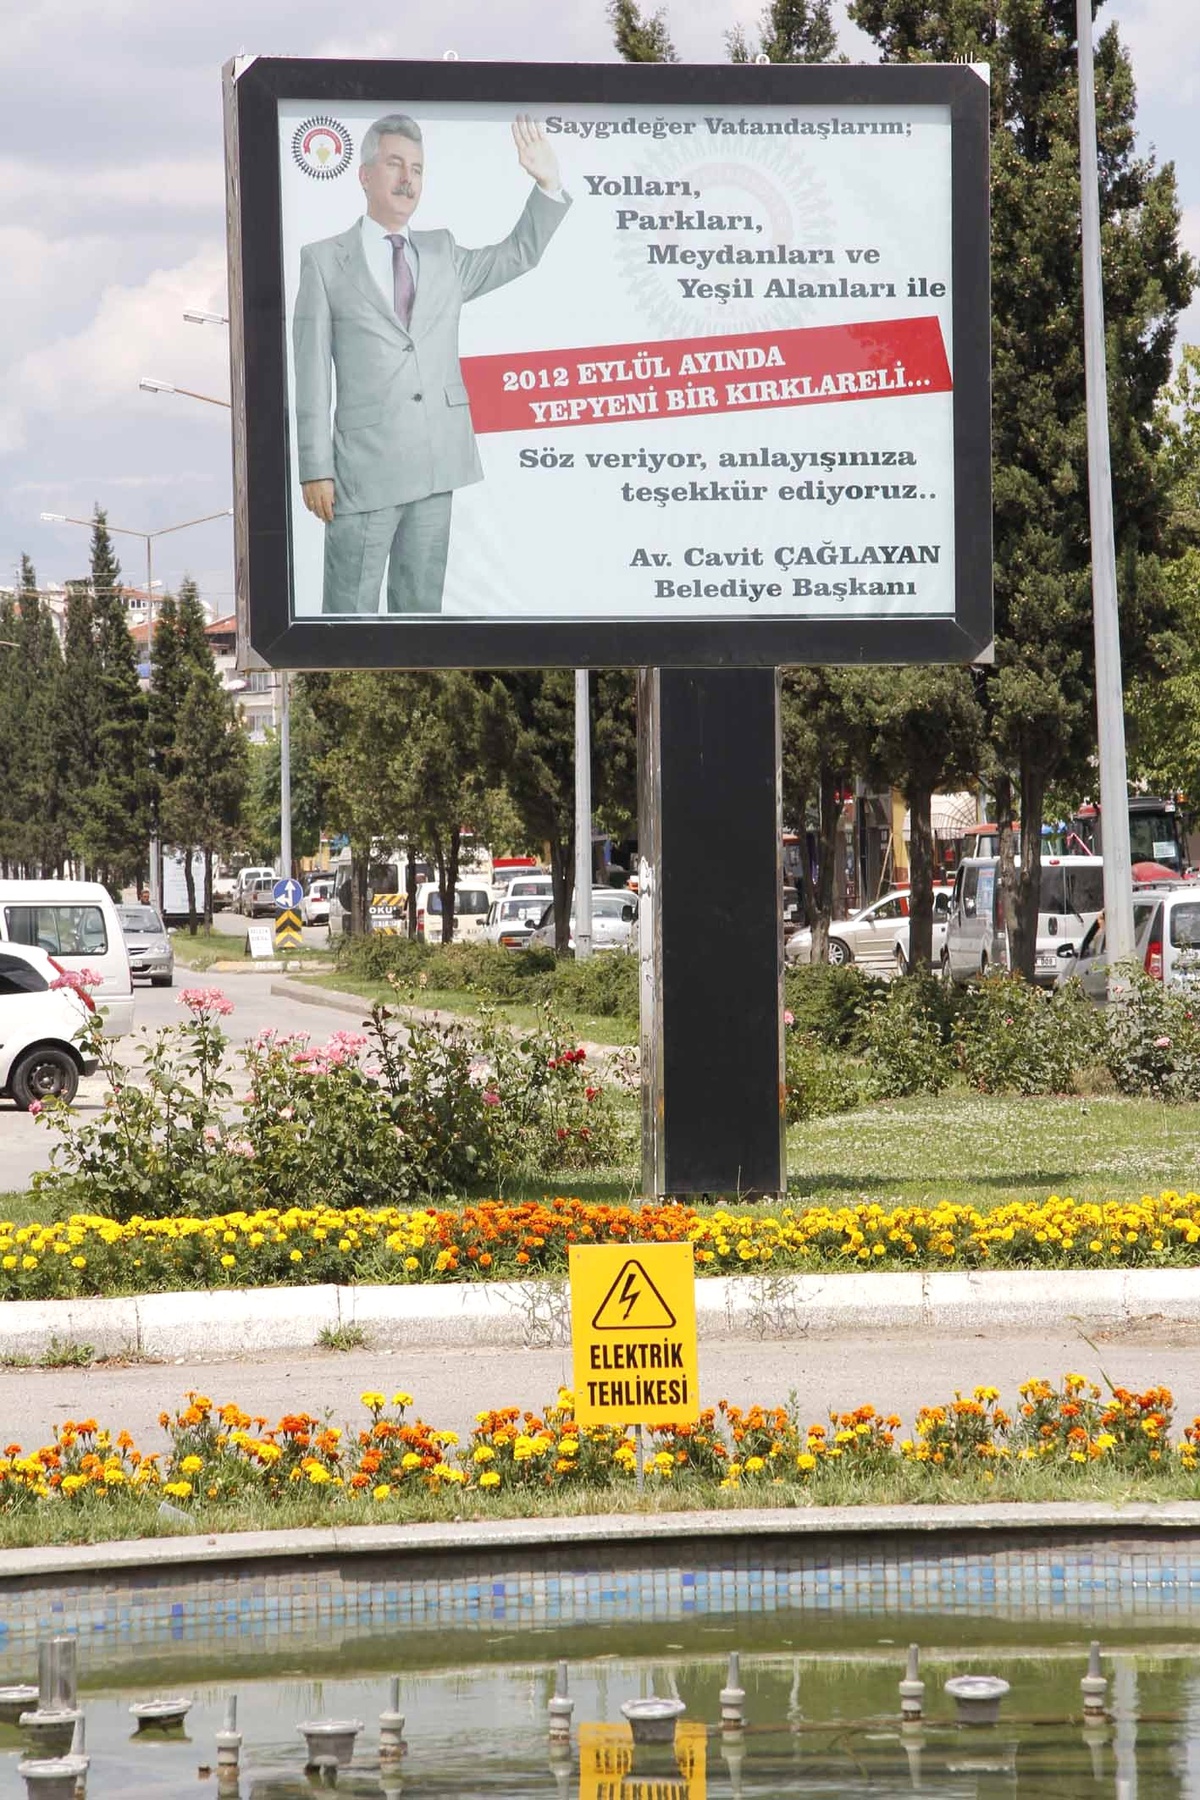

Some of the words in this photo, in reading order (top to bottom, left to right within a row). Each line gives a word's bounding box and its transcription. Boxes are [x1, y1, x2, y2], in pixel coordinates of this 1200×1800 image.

[545, 116, 697, 140] Saygıdeğer
[703, 116, 913, 140] Vatandaşlarım;
[584, 176, 700, 199] Yolları,
[616, 210, 762, 233] Parkları,
[647, 245, 834, 270] Meydanları
[846, 249, 879, 263] ve
[678, 278, 753, 304] Yeşil
[764, 278, 896, 298] Alanları
[908, 278, 945, 297] ile
[503, 368, 569, 391] 2012
[577, 351, 671, 384] EYLÜL
[679, 346, 786, 375] AYINDA
[529, 386, 659, 424] YEPYENİ
[666, 382, 718, 410] BİR
[726, 361, 931, 405] KIRKLARELİ...
[520, 447, 574, 467] Söz
[586, 448, 706, 473] veriyor,
[719, 448, 916, 472] anlayışınıza
[621, 480, 767, 507] teşekkür
[779, 480, 935, 505] ediyoruz..
[630, 549, 671, 566] Av.
[684, 548, 763, 566] Cavit
[775, 542, 940, 571] ÇAĞLAYAN
[655, 579, 782, 602] Belediye
[793, 578, 916, 601] Başkanı
[591, 1338, 683, 1369] ELEKTRİK
[587, 1375, 687, 1406] TEHLİKESİ
